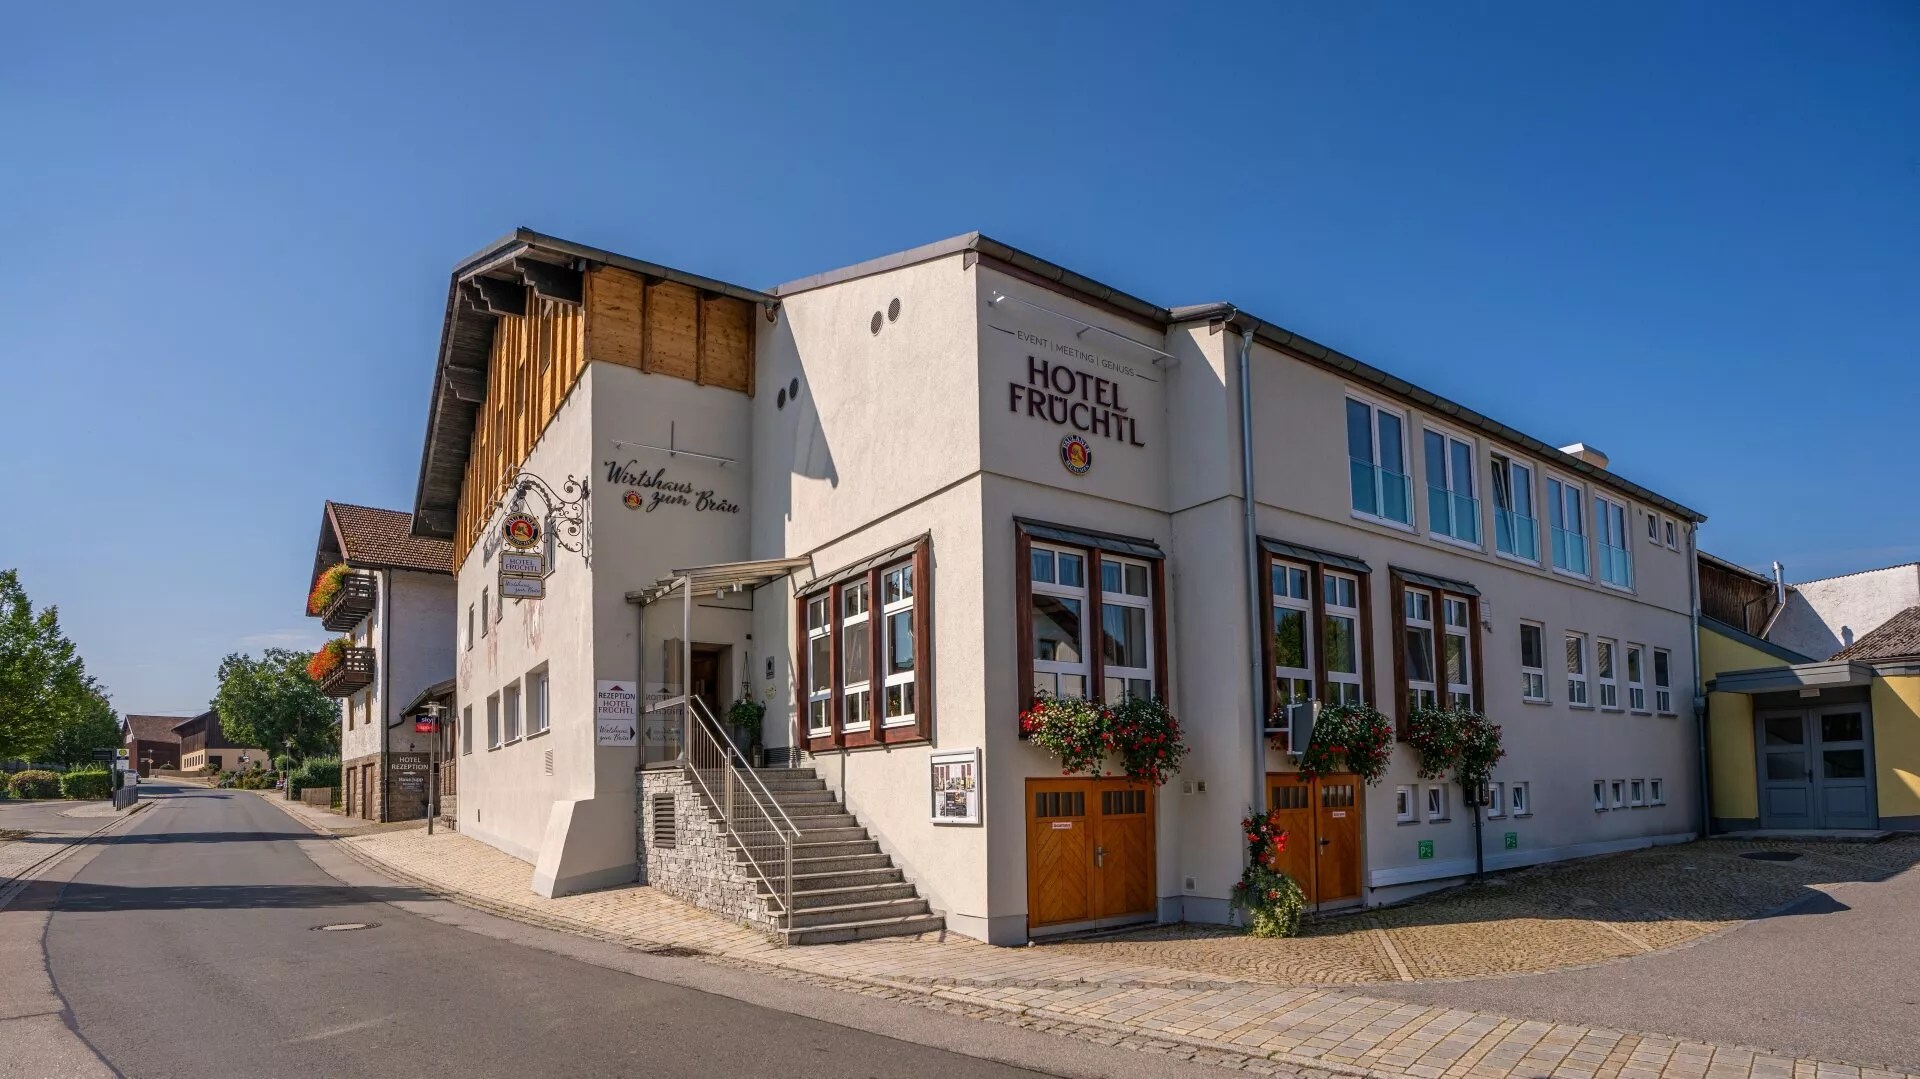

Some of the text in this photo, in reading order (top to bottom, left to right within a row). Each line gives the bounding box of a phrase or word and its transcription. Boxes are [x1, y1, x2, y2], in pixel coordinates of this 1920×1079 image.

[1017, 330, 1135, 377] EVENT MEETING GENUSS
[1028, 355, 1128, 413] HOTEL
[1009, 382, 1145, 447] FRÜCHTL
[604, 459, 693, 494] Wirtshaus
[645, 490, 740, 514] zum Bräu
[510, 558, 534, 566] HOTEL
[598, 692, 636, 700] REZEPTION
